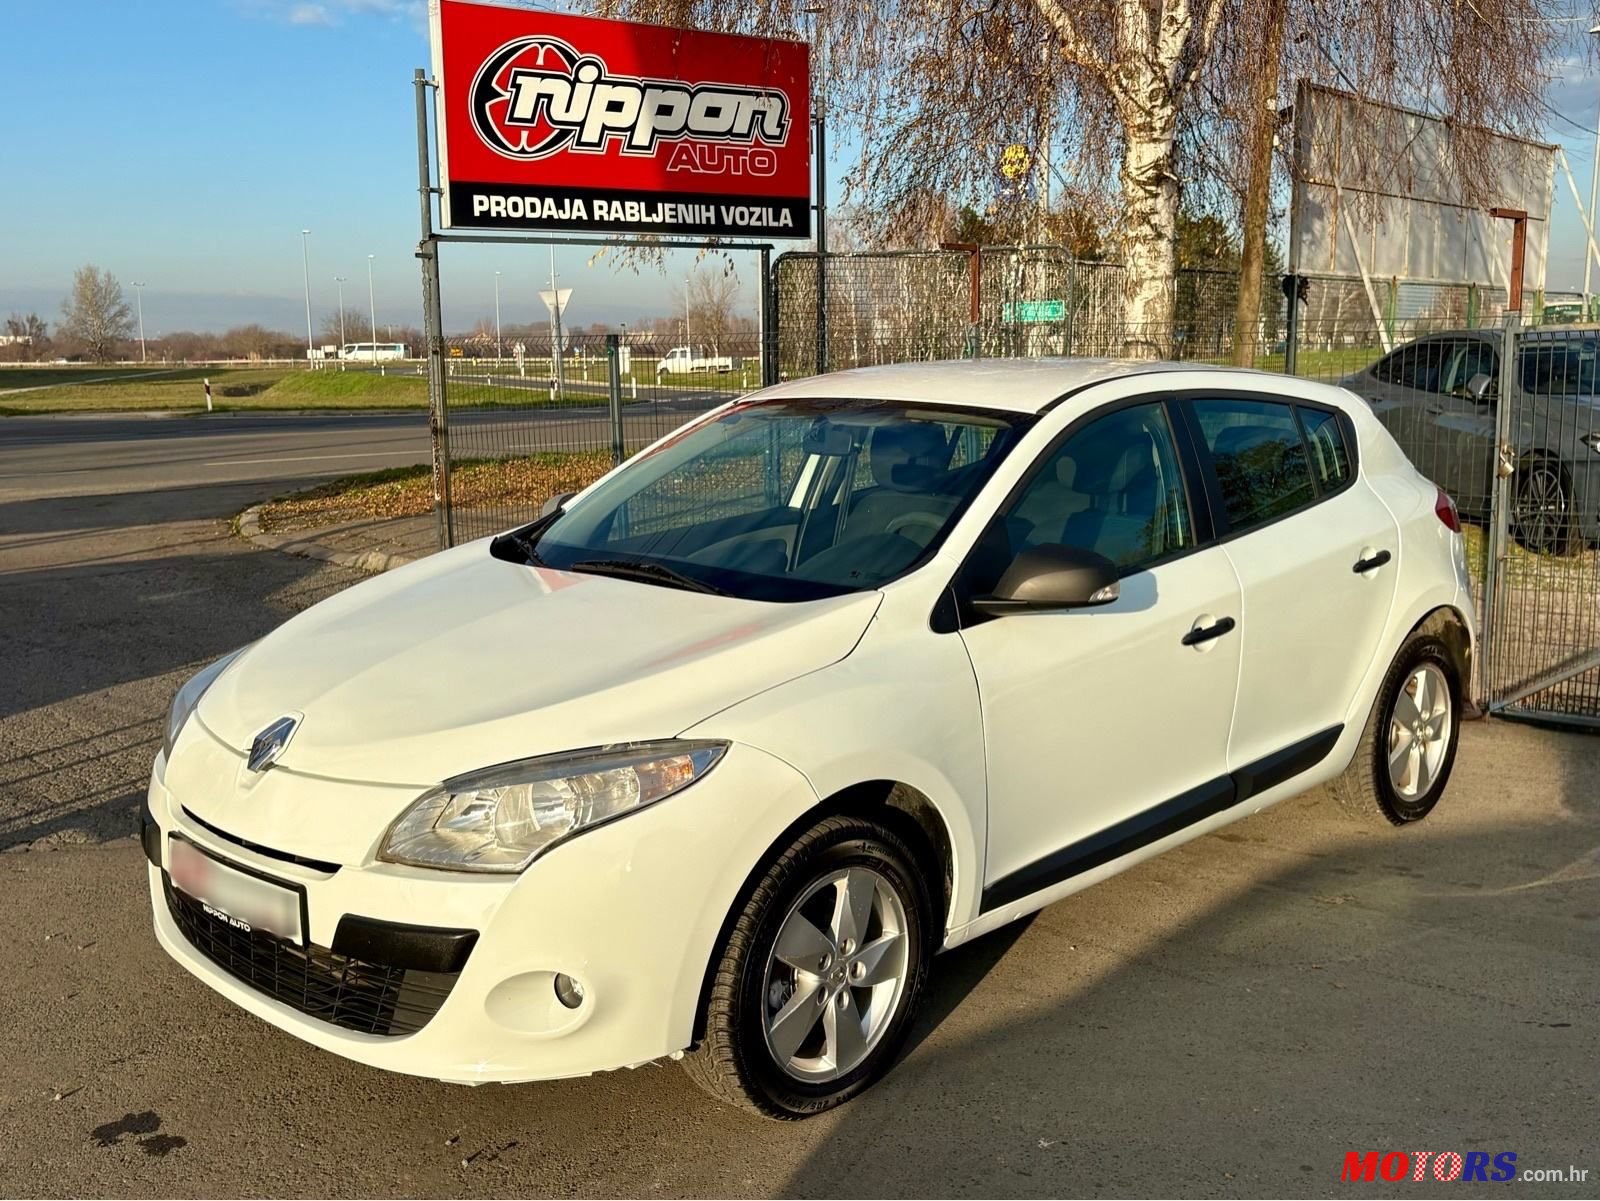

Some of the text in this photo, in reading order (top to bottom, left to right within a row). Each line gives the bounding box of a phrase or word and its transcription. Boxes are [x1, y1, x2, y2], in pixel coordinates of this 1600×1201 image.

[508, 56, 790, 151] nippon
[667, 143, 777, 176] AUTO
[473, 195, 793, 228] PRODAJA RABLJENIH VOZILA
[203, 903, 251, 932] NIPPON AUTO
